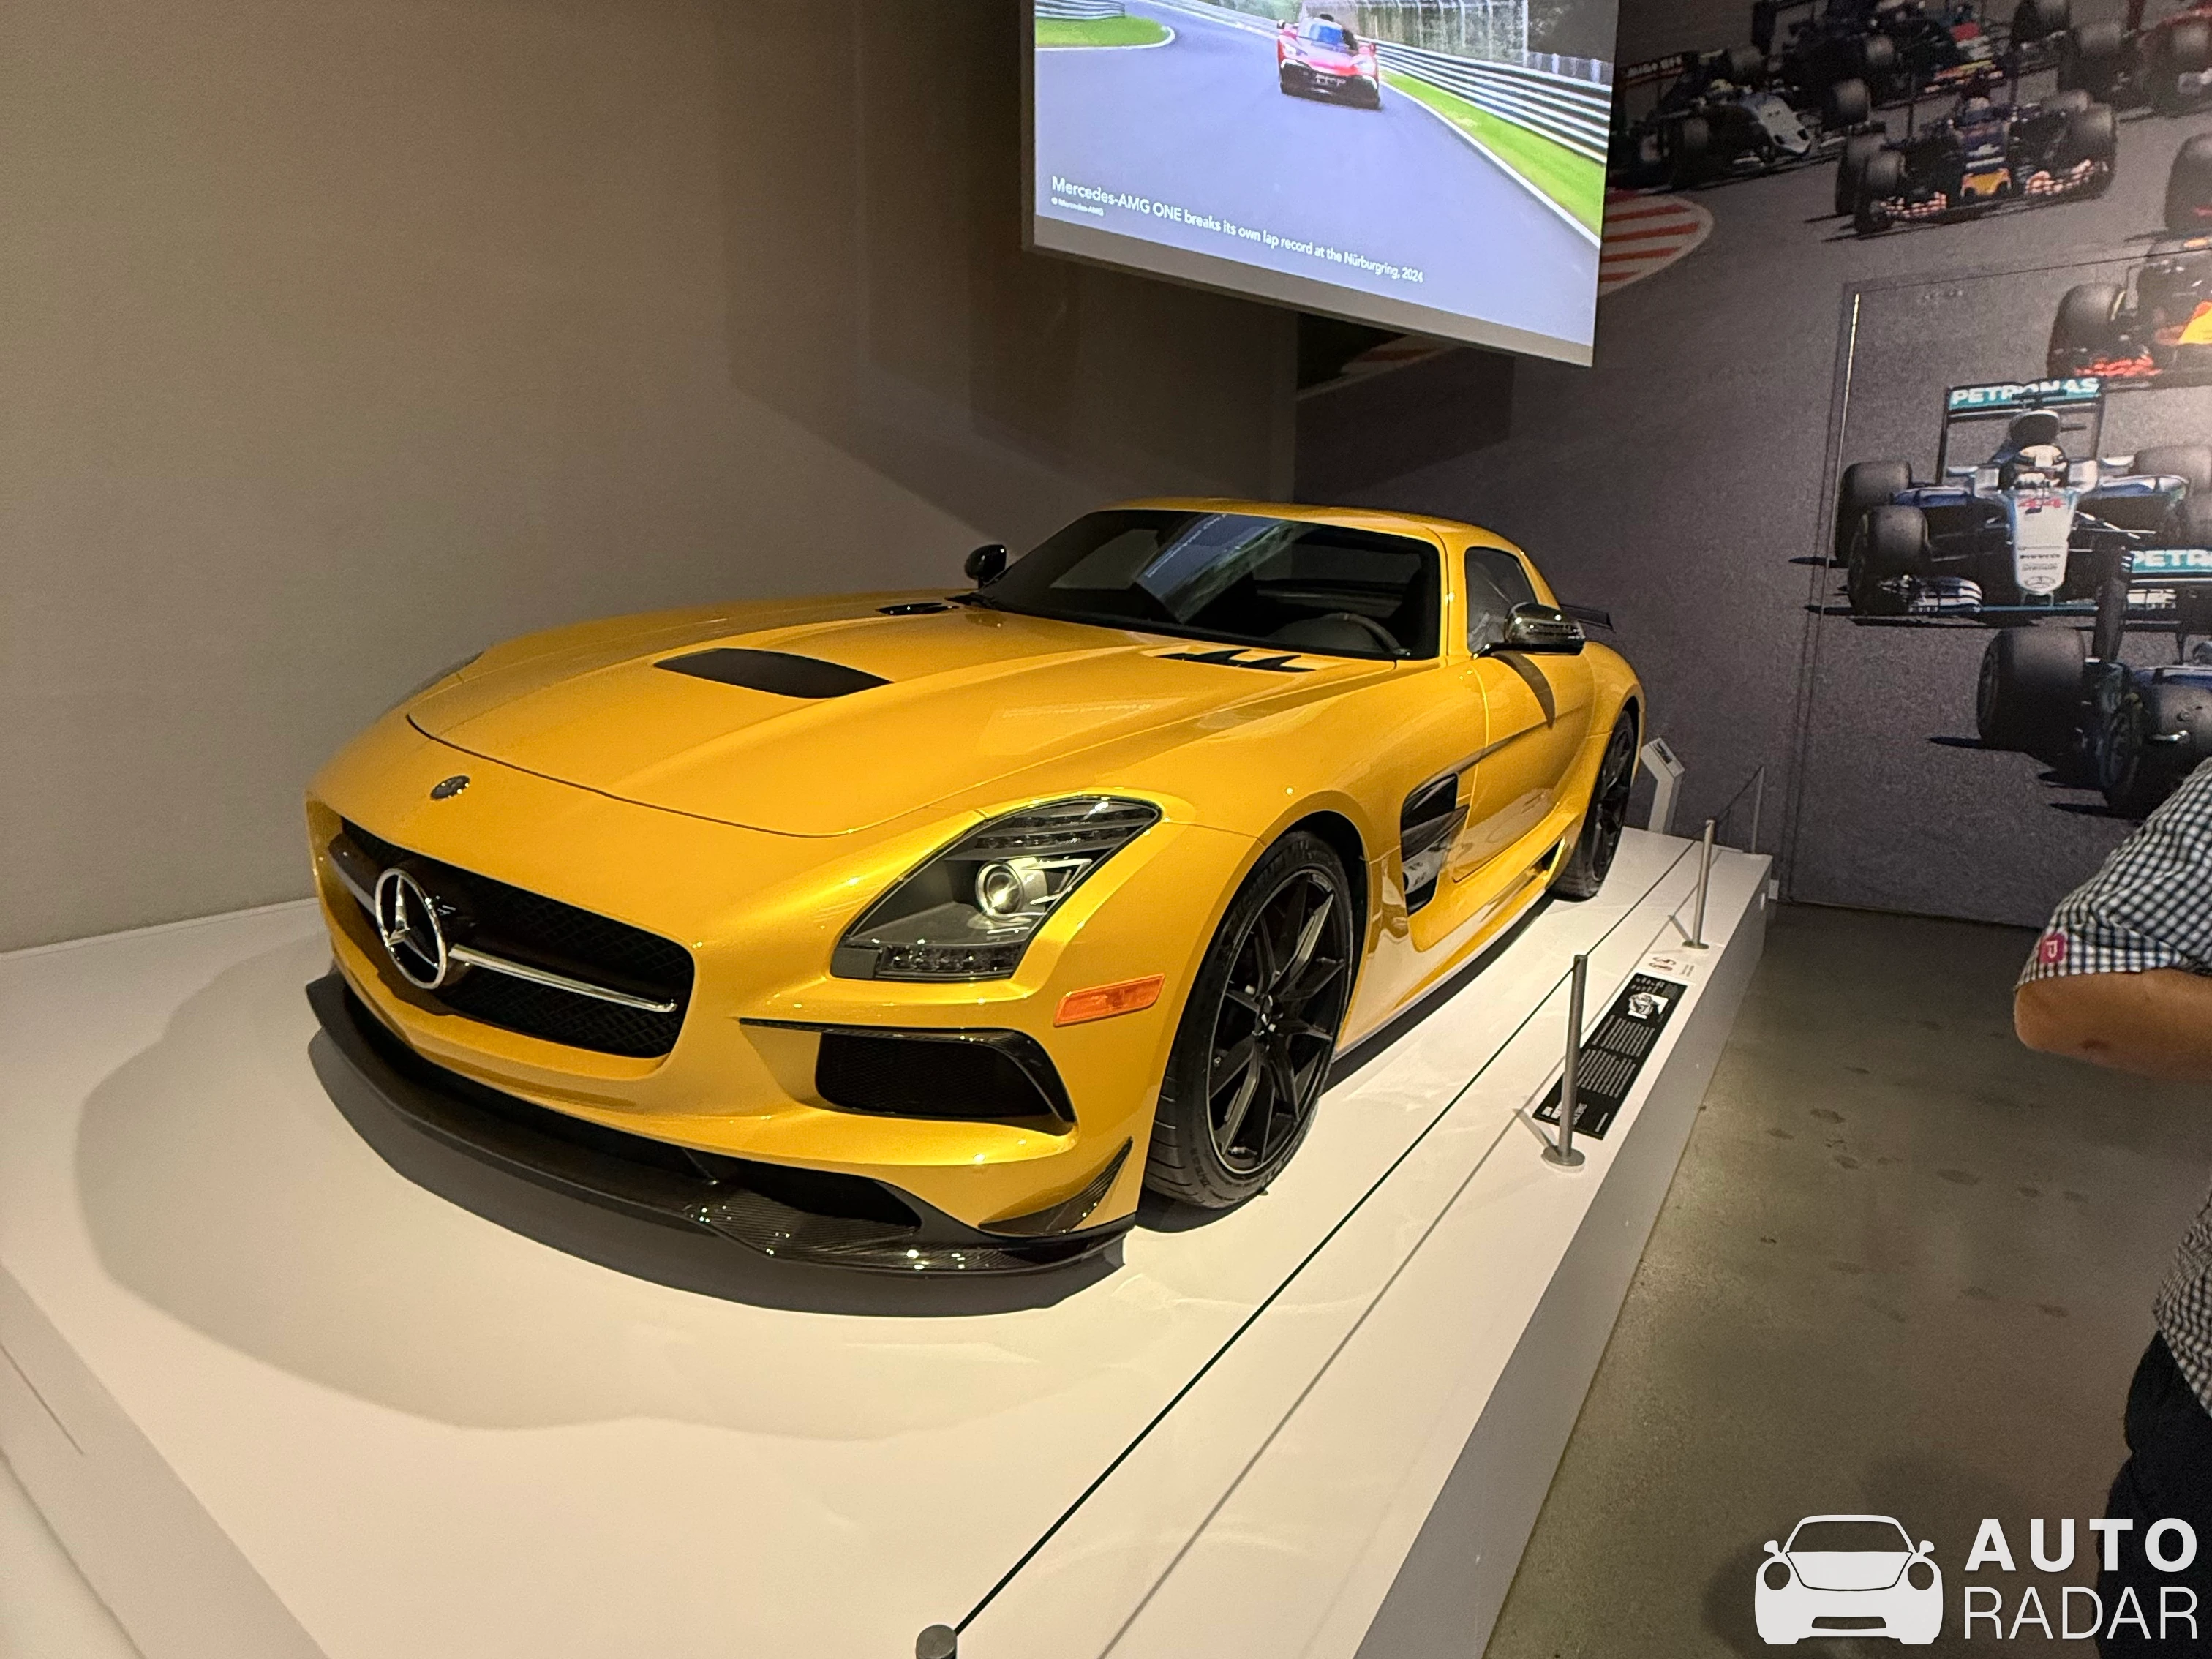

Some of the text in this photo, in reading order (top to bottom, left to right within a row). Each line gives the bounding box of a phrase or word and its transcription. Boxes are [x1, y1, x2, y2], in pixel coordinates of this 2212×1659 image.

[1051, 176, 1151, 214] Mercedes-AMG
[1152, 202, 1183, 222] ONE
[1184, 209, 1222, 232] breaks
[1222, 219, 1237, 236] its
[1238, 226, 1262, 242] own
[1263, 229, 1280, 249] lap
[1280, 237, 1314, 255] record
[1314, 245, 1325, 259] at
[1325, 247, 1343, 263] the
[1402, 266, 1424, 284] 2024
[2130, 549, 2212, 567] PETR
